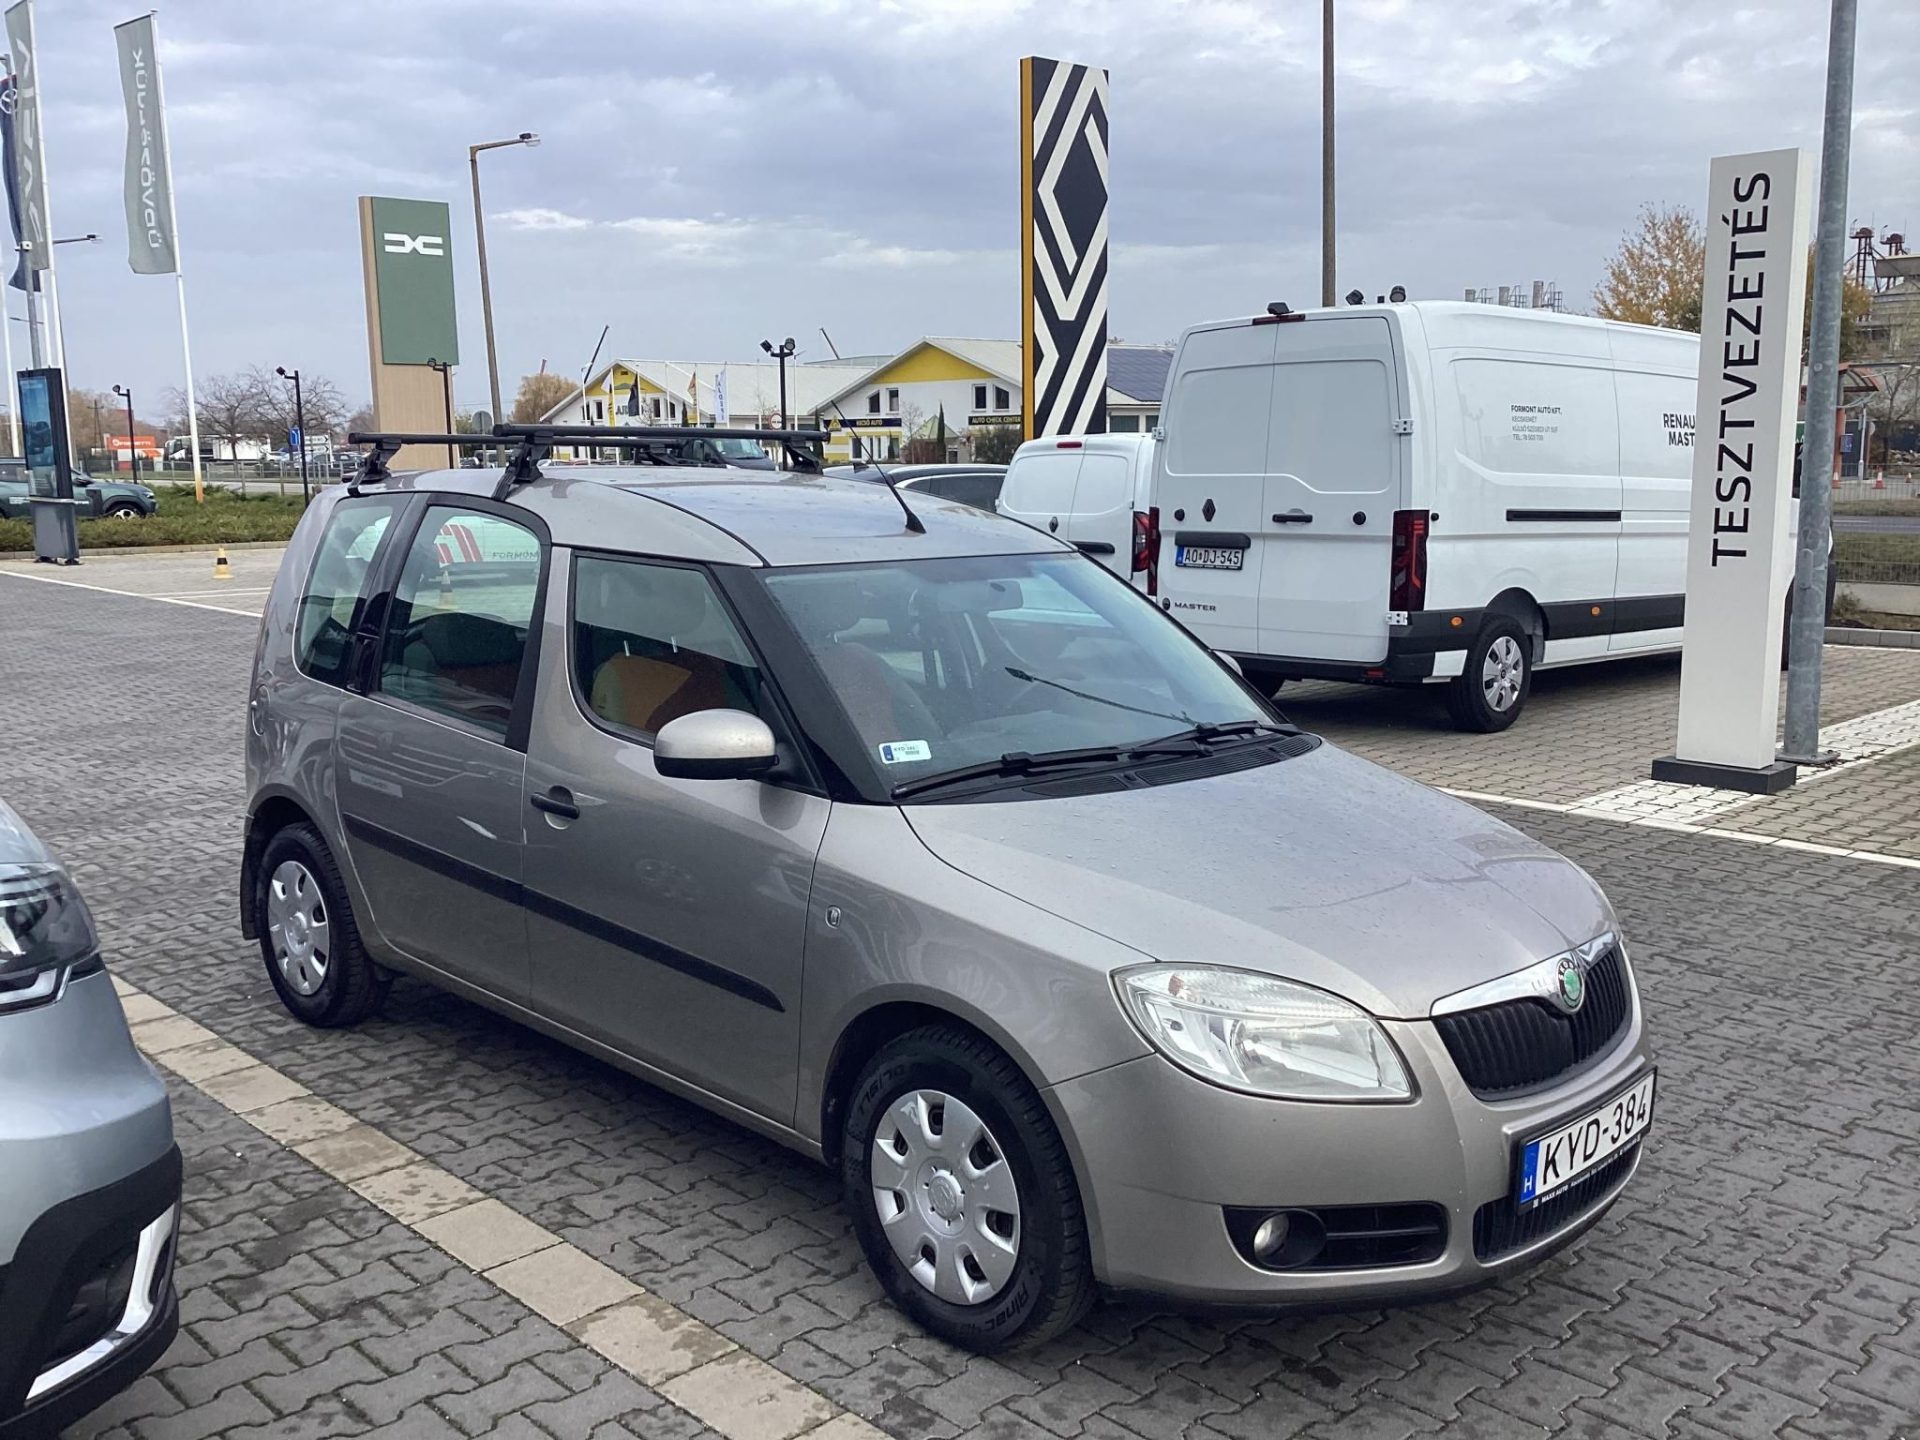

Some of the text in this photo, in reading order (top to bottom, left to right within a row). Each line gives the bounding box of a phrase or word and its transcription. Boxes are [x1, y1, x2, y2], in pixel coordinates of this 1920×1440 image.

[1711, 172, 1771, 566] TESZTVEZETÉS
[1511, 404, 1537, 413] FORMONT
[1663, 413, 1696, 430] RENAU
[1668, 431, 1696, 446] MAST
[492, 551, 539, 560] FORMON
[1185, 548, 1241, 565] AO DJ-545
[1174, 602, 1217, 612] MASTER
[1542, 1084, 1648, 1186] KYD-384
[1523, 1175, 1534, 1194] H
